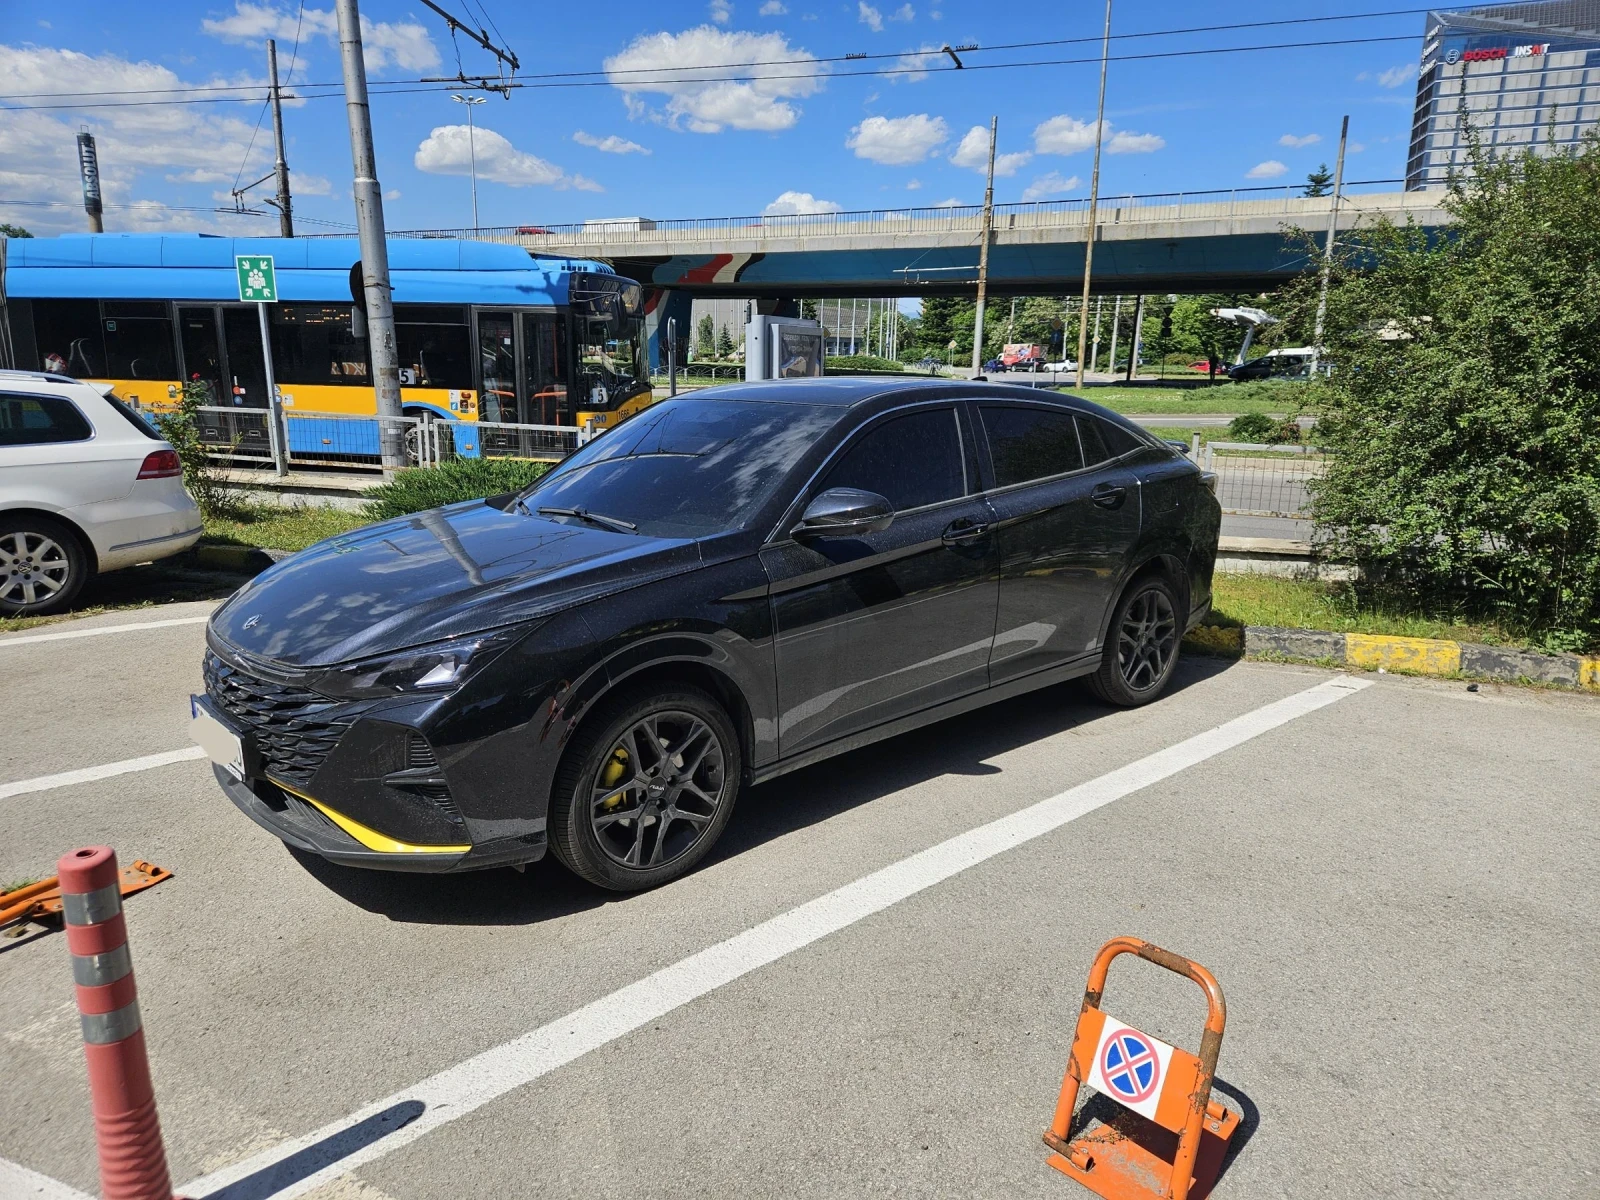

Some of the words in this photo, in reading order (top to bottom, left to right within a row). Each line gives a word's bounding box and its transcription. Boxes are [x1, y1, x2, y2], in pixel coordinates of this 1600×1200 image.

[1463, 47, 1508, 61] BOSCH
[1514, 43, 1550, 57] INSAIT
[399, 370, 409, 384] 5
[598, 389, 604, 403] 5
